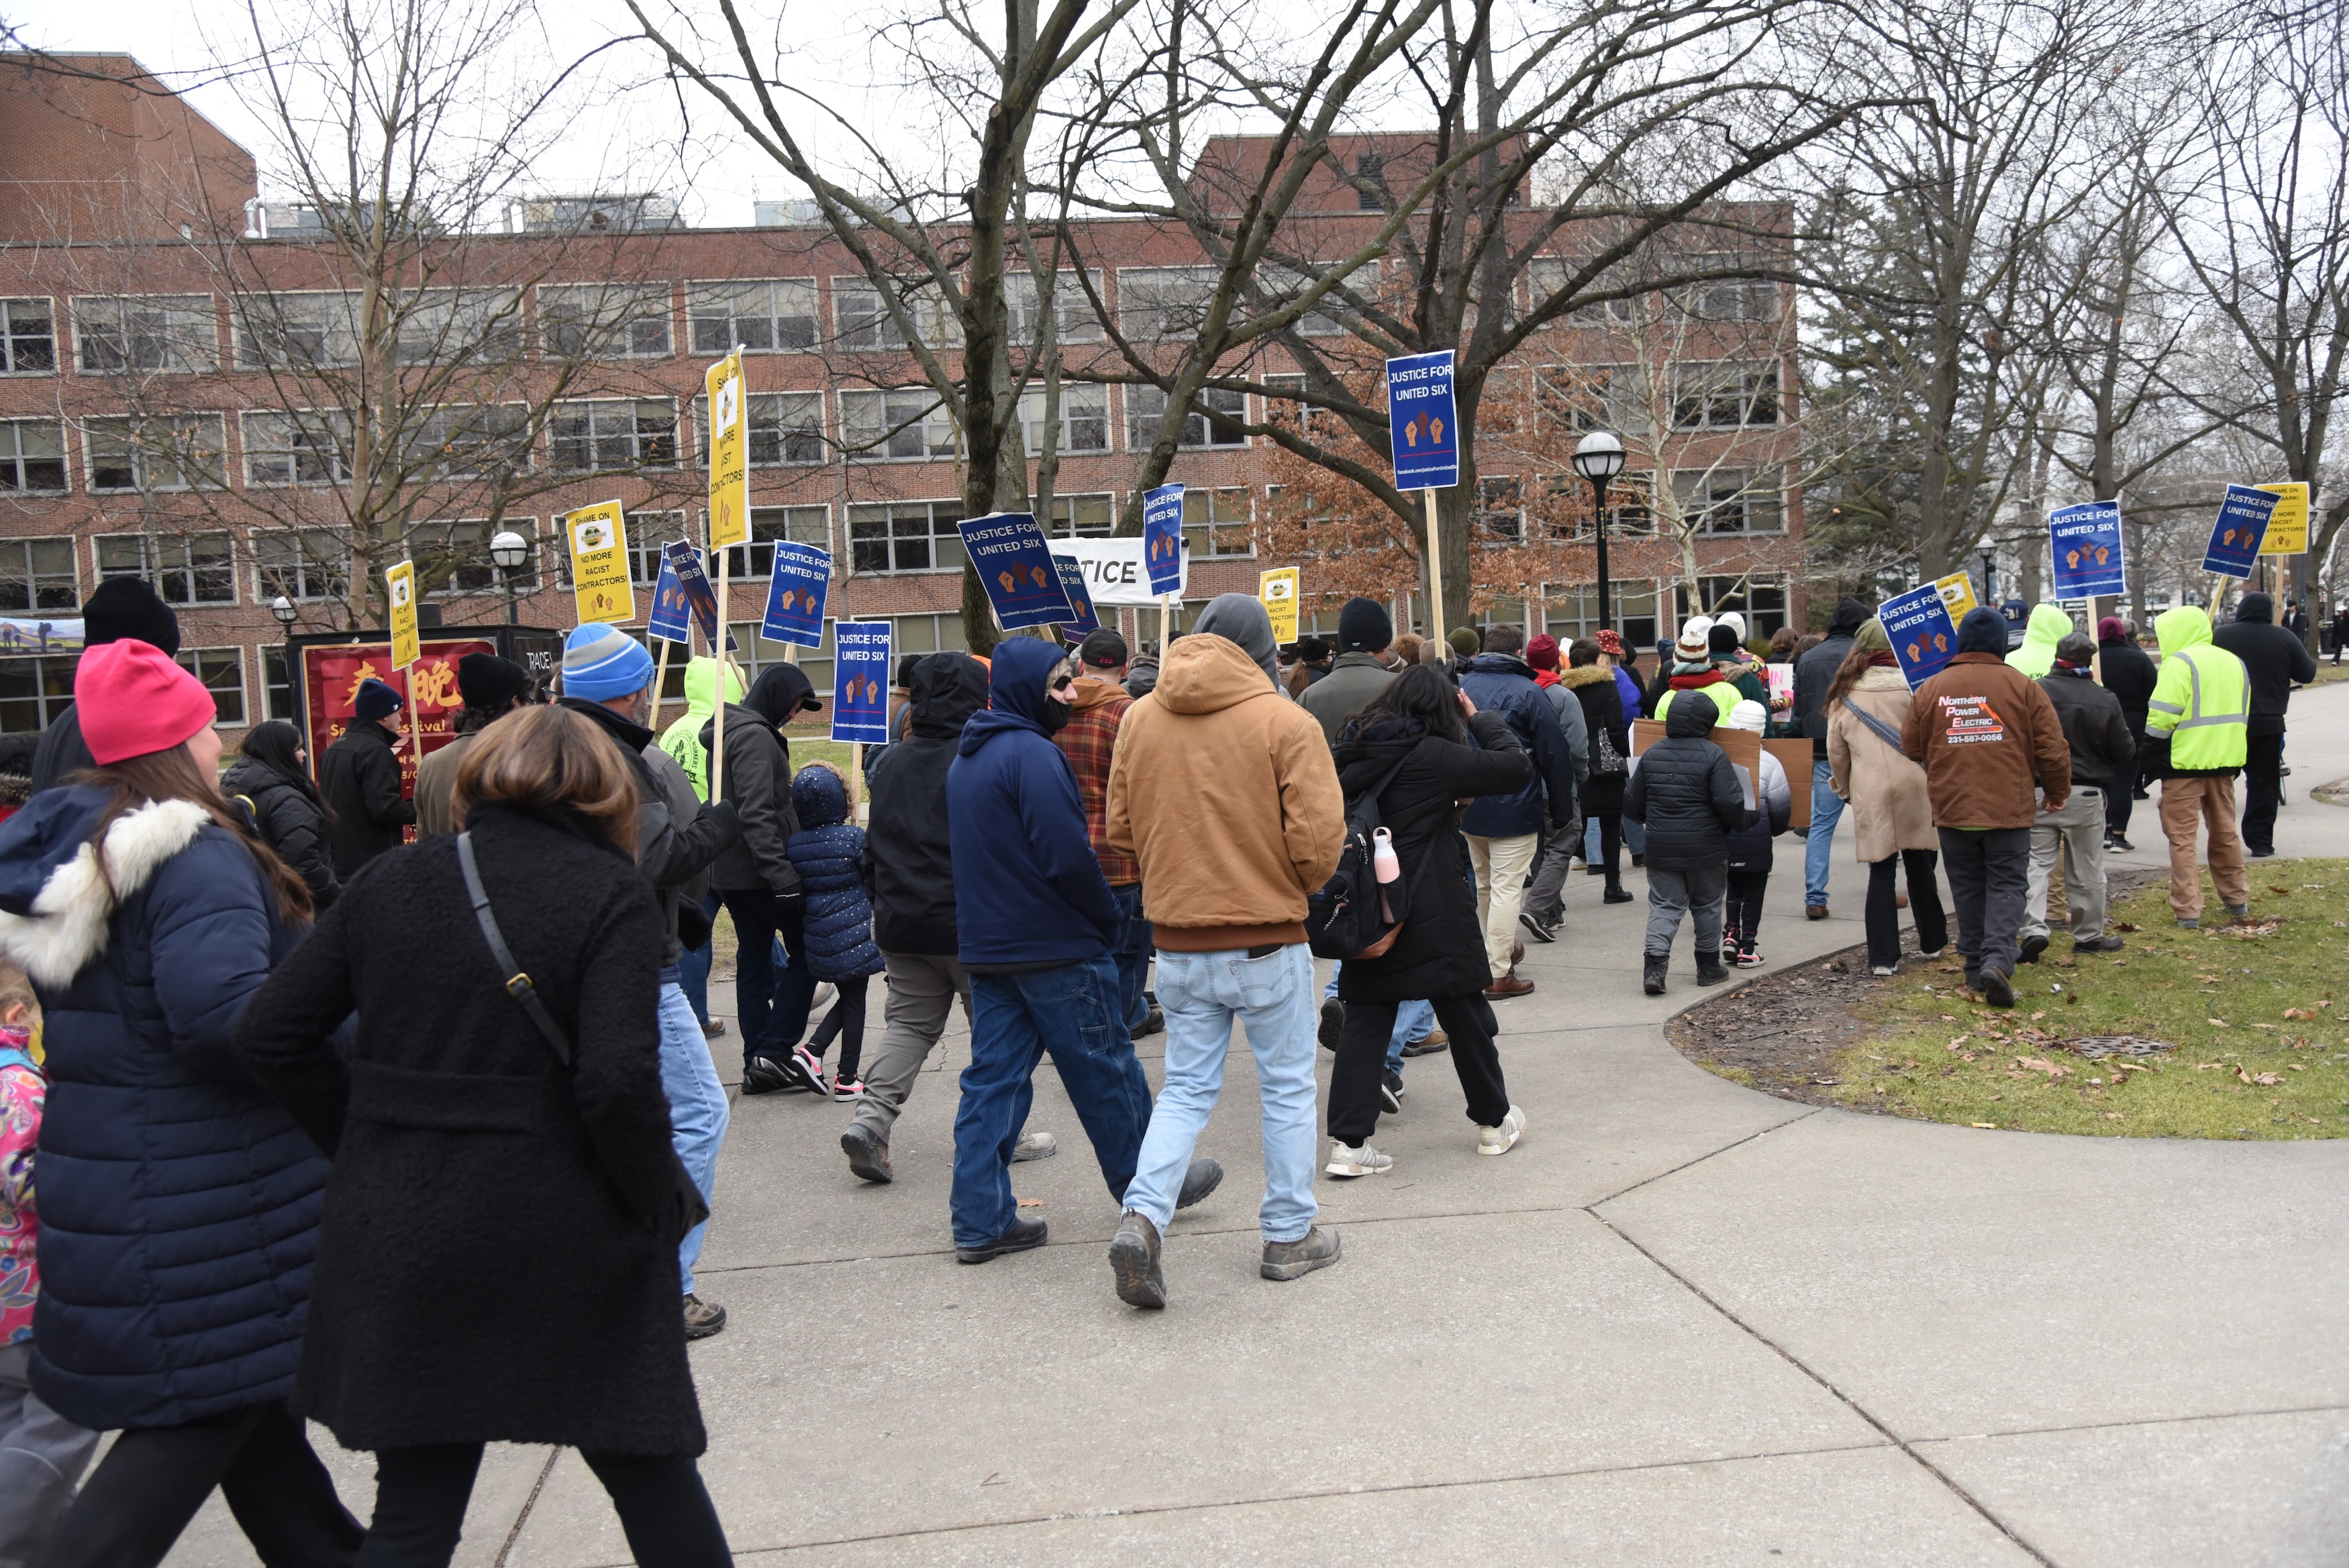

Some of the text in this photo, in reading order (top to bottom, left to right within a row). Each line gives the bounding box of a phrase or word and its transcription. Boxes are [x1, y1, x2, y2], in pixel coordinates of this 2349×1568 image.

[1390, 365, 1452, 383] JUSTICE FOR
[1396, 384, 1448, 401] UNITED SIX
[1146, 492, 1182, 510] JUSTICE FOR
[2227, 493, 2276, 509] JUSTICE FOR
[576, 512, 609, 525] SHAME ON
[1148, 508, 1178, 524] UNITED SIX
[2052, 509, 2117, 525] JUSTICE FOR
[2227, 506, 2267, 520] UNITED SIX
[966, 523, 1040, 543] JUSTICE FOR
[2057, 523, 2114, 537] UNITED SIX
[977, 539, 1042, 556] UNITED SIX
[581, 551, 612, 564] NO MORE
[778, 550, 831, 569] JUSTICE FOR
[585, 565, 610, 576] RACIST
[693, 567, 702, 577] SIX
[781, 564, 826, 581] UNITED SIX
[1064, 564, 1081, 572] FOR
[1081, 560, 1137, 583] TICE
[577, 575, 628, 591] CONTRACTORS!
[1882, 593, 1941, 621] JUSTICE FOR
[1950, 606, 1964, 615] ACIST
[1890, 613, 1925, 632] UNITED
[1927, 607, 1943, 619] SIX
[839, 635, 889, 644] JUSTICE FOR
[842, 651, 885, 661] UNITED SIX
[1938, 696, 1987, 706] NORTHERN
[1946, 707, 1979, 717] POWER
[397, 719, 446, 733] esival
[1952, 717, 1993, 727] ELECTRIC
[1948, 733, 2002, 743] 231-587-0056
[691, 739, 699, 770] WORKERS
